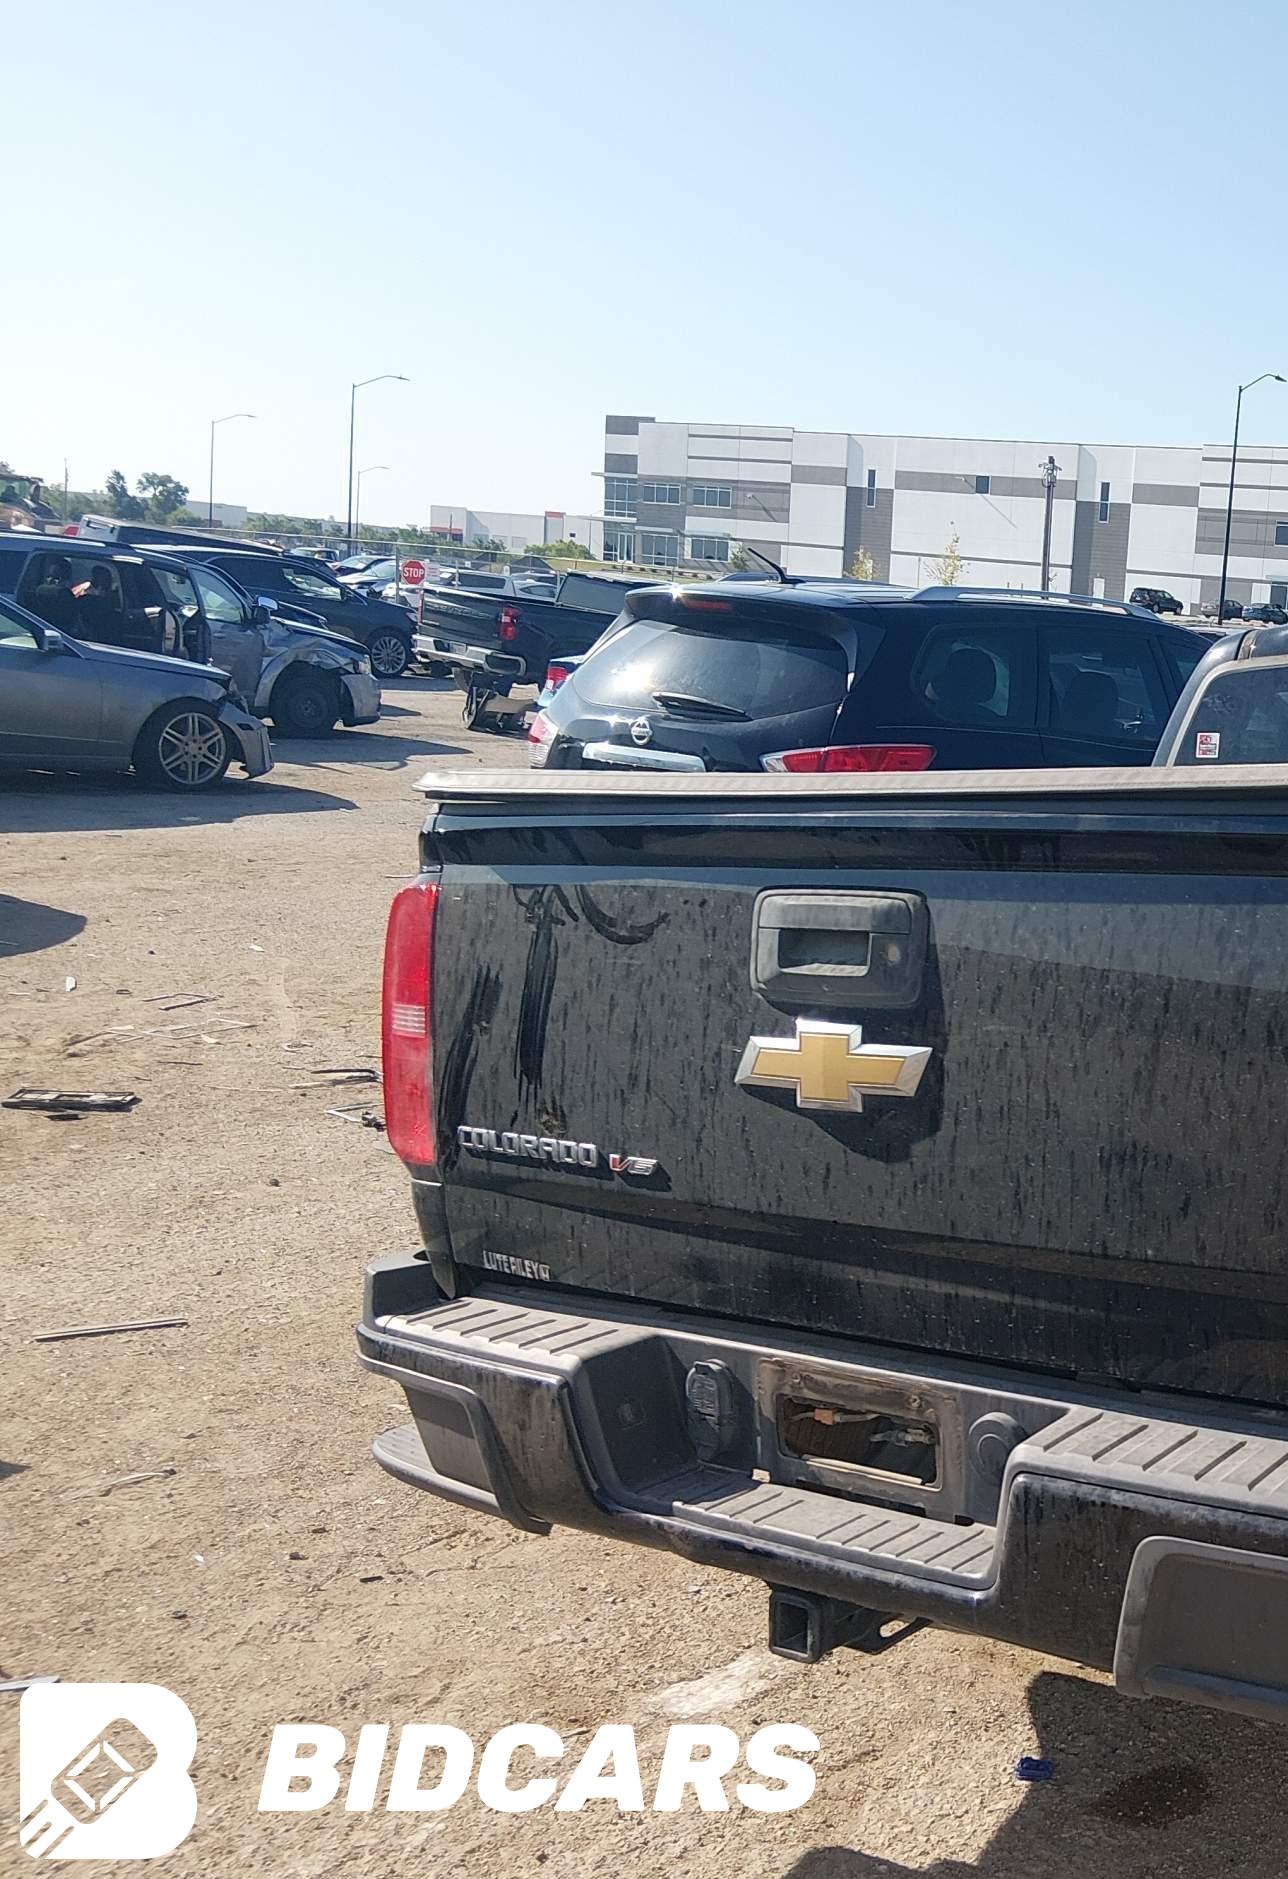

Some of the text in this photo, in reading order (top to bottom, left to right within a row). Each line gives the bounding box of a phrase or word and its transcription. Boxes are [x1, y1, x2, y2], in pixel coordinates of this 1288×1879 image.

[403, 567, 425, 578] STOP
[457, 1125, 660, 1176] COLORADO V6
